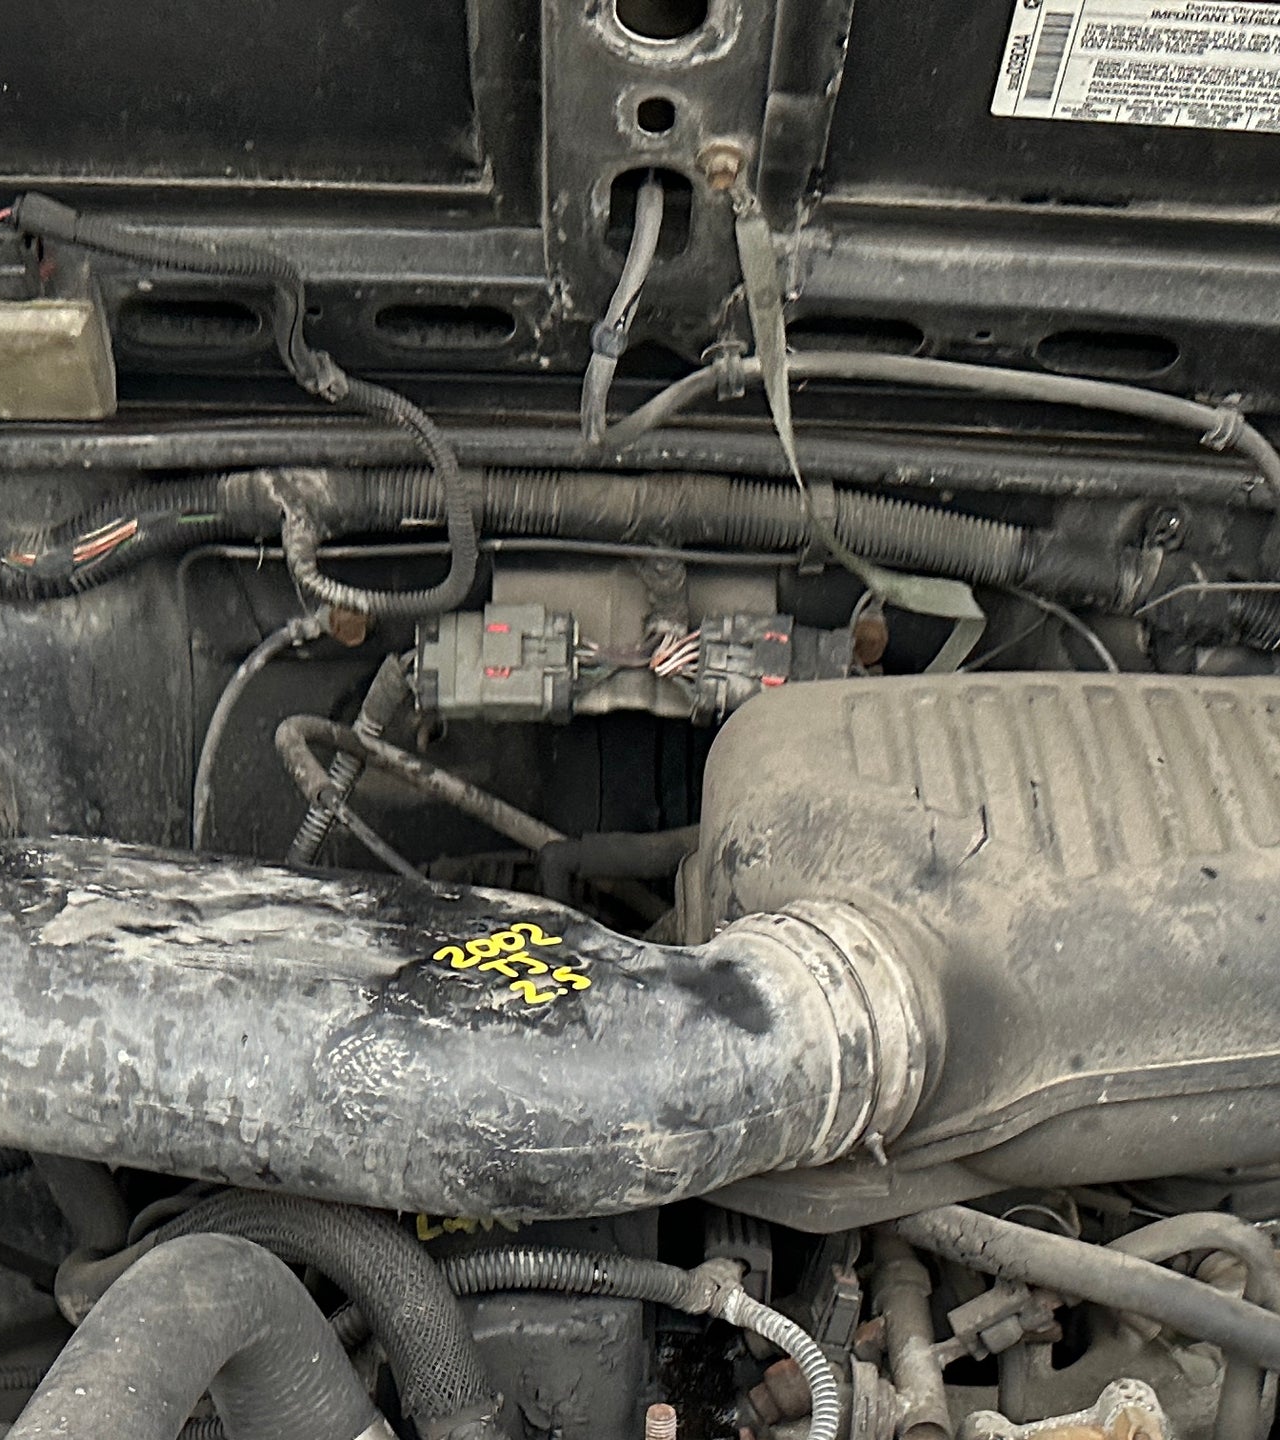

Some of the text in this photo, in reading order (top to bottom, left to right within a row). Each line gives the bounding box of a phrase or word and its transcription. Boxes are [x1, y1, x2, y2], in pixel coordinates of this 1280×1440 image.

[1150, 8, 1229, 24] IMPORTANT
[1186, 1, 1280, 17] DaimlerChrysler
[433, 923, 563, 969] 2002
[478, 951, 549, 978] TJ
[509, 966, 592, 1004] 2.5
